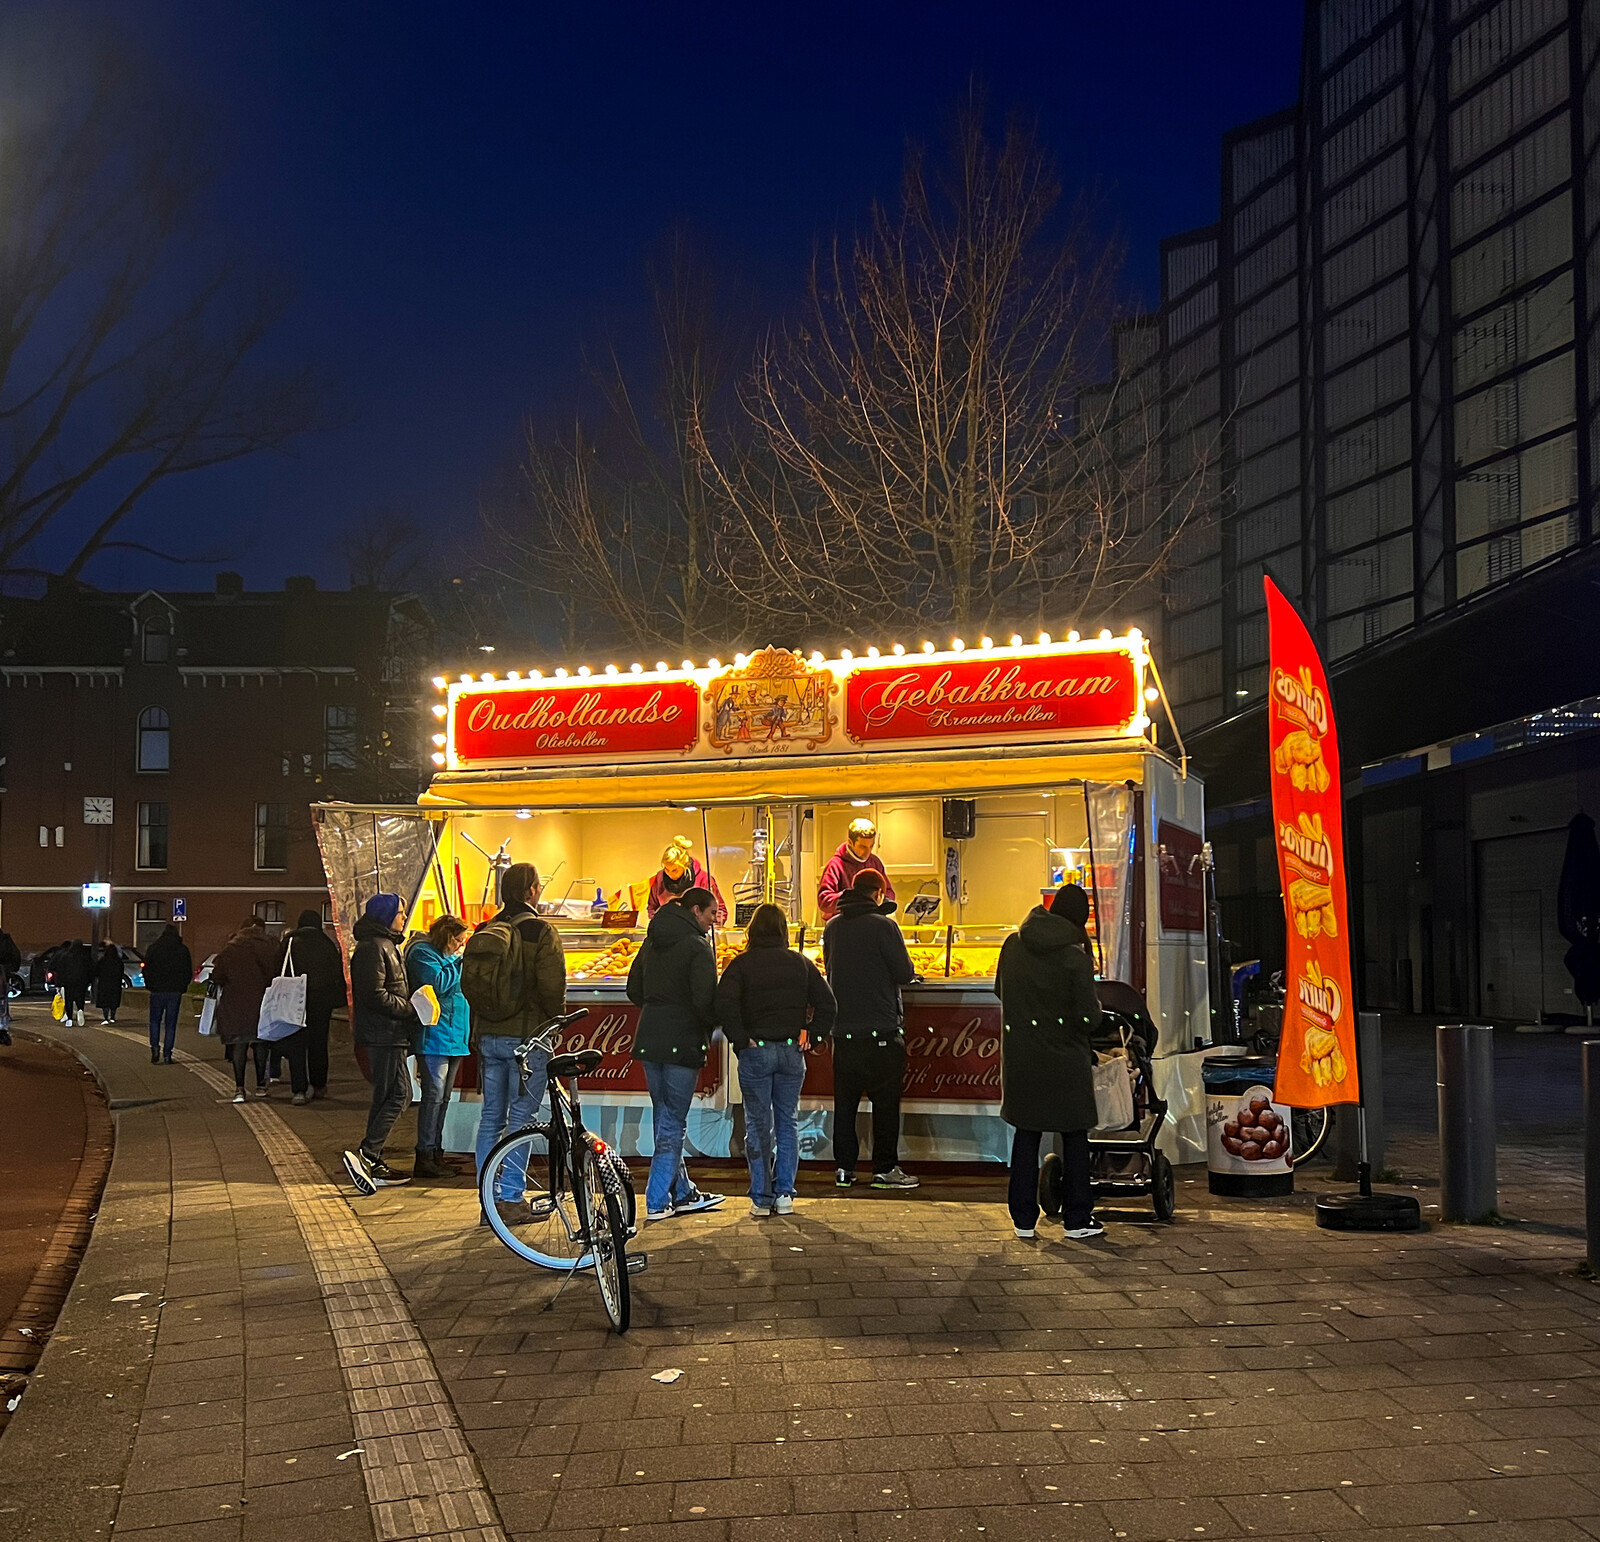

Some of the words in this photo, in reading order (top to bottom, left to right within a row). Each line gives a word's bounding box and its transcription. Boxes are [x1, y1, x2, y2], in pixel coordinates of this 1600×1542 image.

[861, 665, 1121, 728] Gebakkraam
[467, 690, 683, 733] Oudhollandse
[926, 705, 1057, 728] Krentenbollen
[535, 733, 609, 750] Oliebollen
[770, 744, 790, 753] 1881
[87, 896, 106, 904] P+R
[175, 899, 184, 908] P
